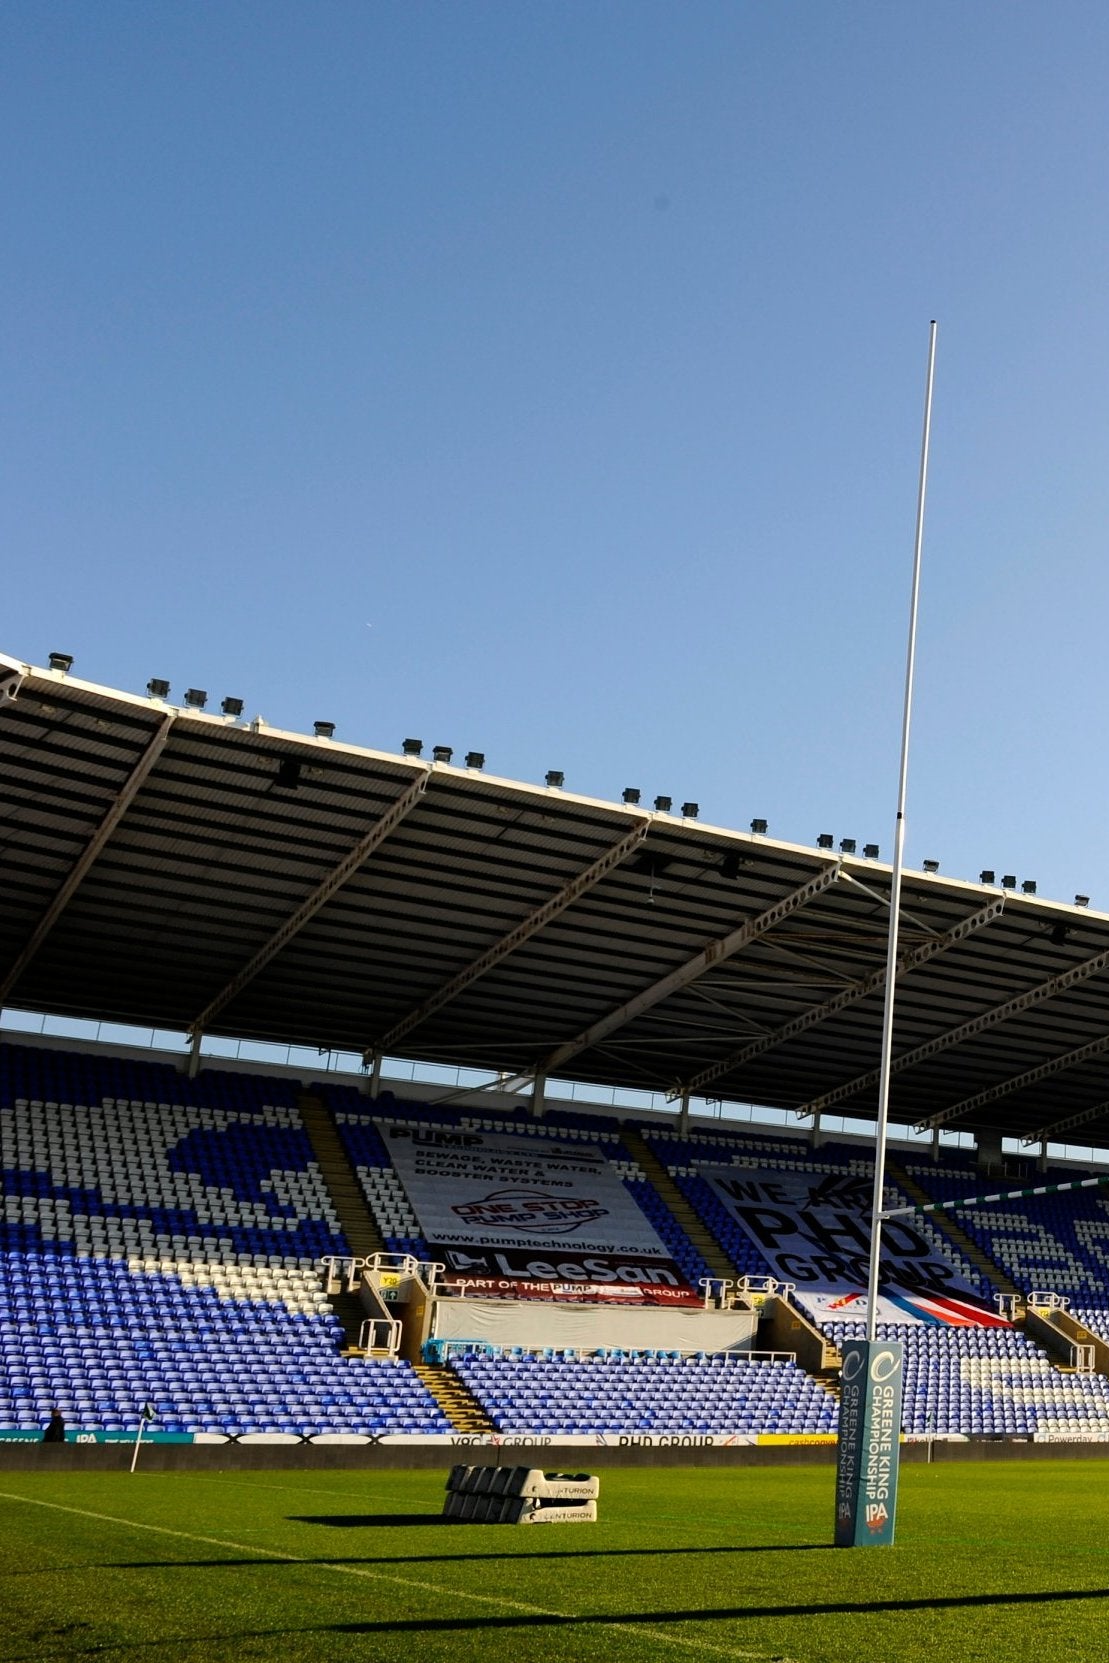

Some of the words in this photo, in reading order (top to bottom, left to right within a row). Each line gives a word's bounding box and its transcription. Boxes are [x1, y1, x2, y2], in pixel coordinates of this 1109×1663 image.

[390, 1127, 484, 1147] PUMP
[415, 1158, 467, 1170] CLEAN
[474, 1164, 529, 1176] WATER
[491, 1157, 543, 1169] WASTE
[547, 1163, 602, 1175] WATER,
[415, 1168, 494, 1181] BOOSTER
[500, 1175, 573, 1188] SYSTEMS
[714, 1178, 797, 1206] WE
[451, 1204, 513, 1216] ONE
[522, 1199, 601, 1213] STOP
[461, 1212, 536, 1225] PUMP
[546, 1208, 610, 1221] SHOP
[734, 1205, 933, 1259] PHD
[433, 1233, 662, 1254] www.pumptechnology.co.uk
[493, 1253, 680, 1286] LeeSan
[776, 1252, 955, 1289] GROUP
[456, 1278, 496, 1289] PART
[497, 1280, 519, 1289] OF
[519, 1281, 551, 1292] THE
[553, 1283, 592, 1294] PUMP
[643, 1288, 691, 1299] GROUP
[848, 1384, 860, 1451] GREENE
[879, 1384, 895, 1452] GREENE
[503, 1437, 551, 1446] GROUP
[658, 1436, 714, 1446] GROUP
[838, 1384, 851, 1499] CHAMPIONSHIP
[866, 1385, 883, 1500] CHAMPIONSHIP
[1049, 1435, 1093, 1443] Powerday
[845, 1456, 856, 1499] KING
[876, 1455, 892, 1500] KING
[866, 1503, 889, 1522] IPA
